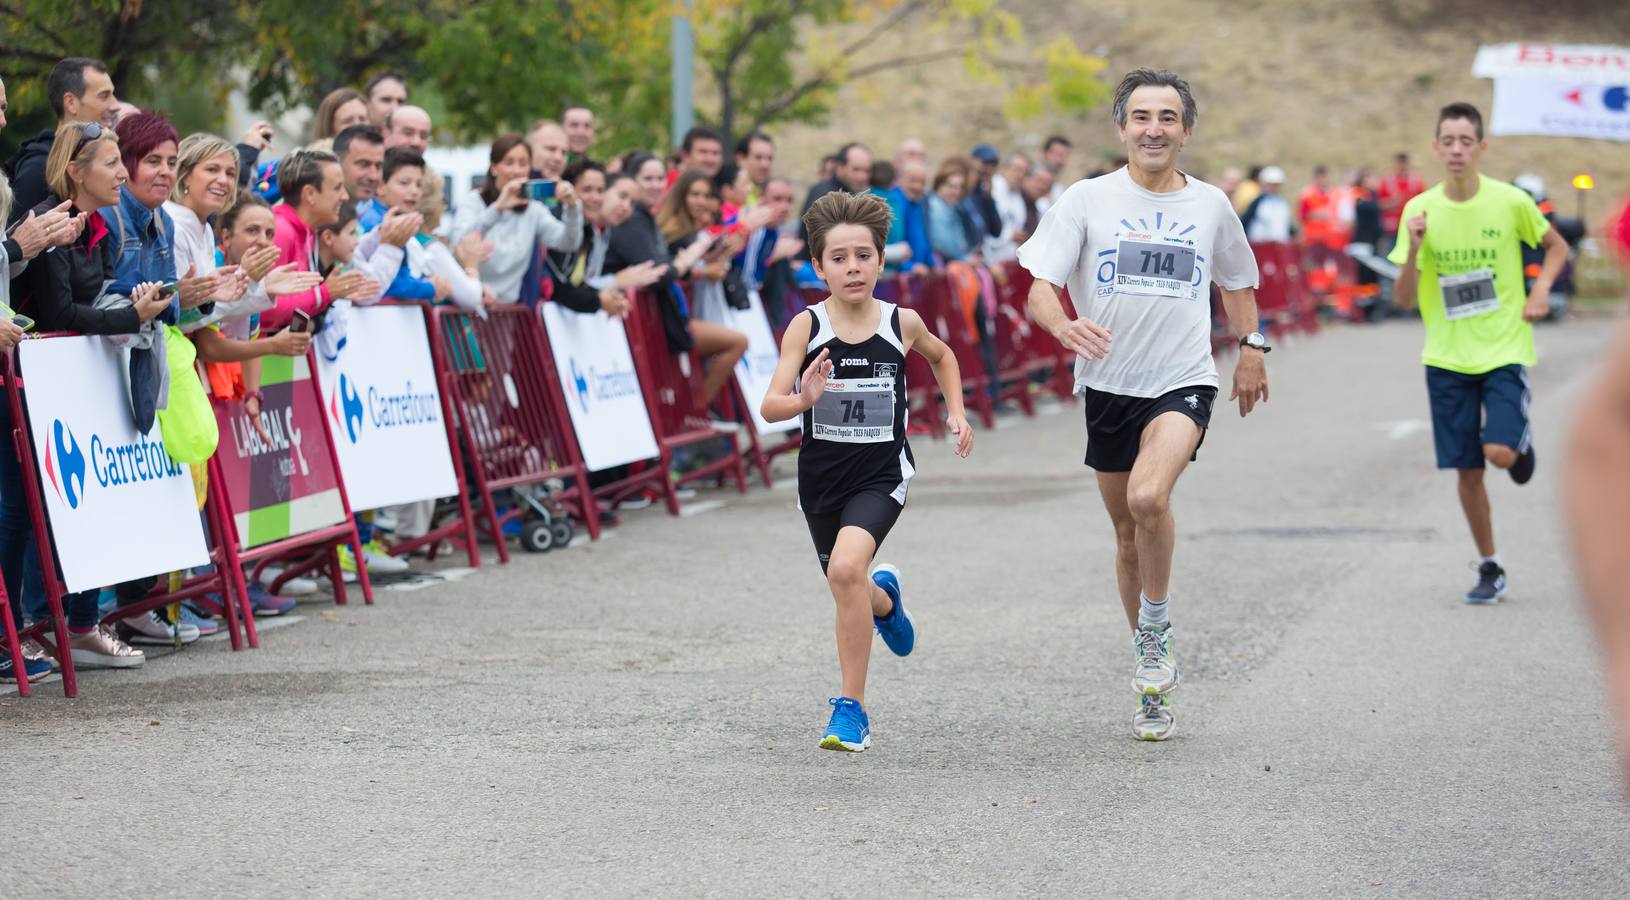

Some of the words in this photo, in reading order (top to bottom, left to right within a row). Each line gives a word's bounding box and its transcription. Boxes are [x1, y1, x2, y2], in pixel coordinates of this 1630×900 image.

[1140, 250, 1175, 276] 714
[1117, 275, 1127, 285] XIV
[1456, 285, 1480, 304] 137
[368, 380, 438, 428] Carrefour
[840, 399, 866, 423] 74
[815, 425, 825, 435] XIV
[854, 428, 863, 437] TRES
